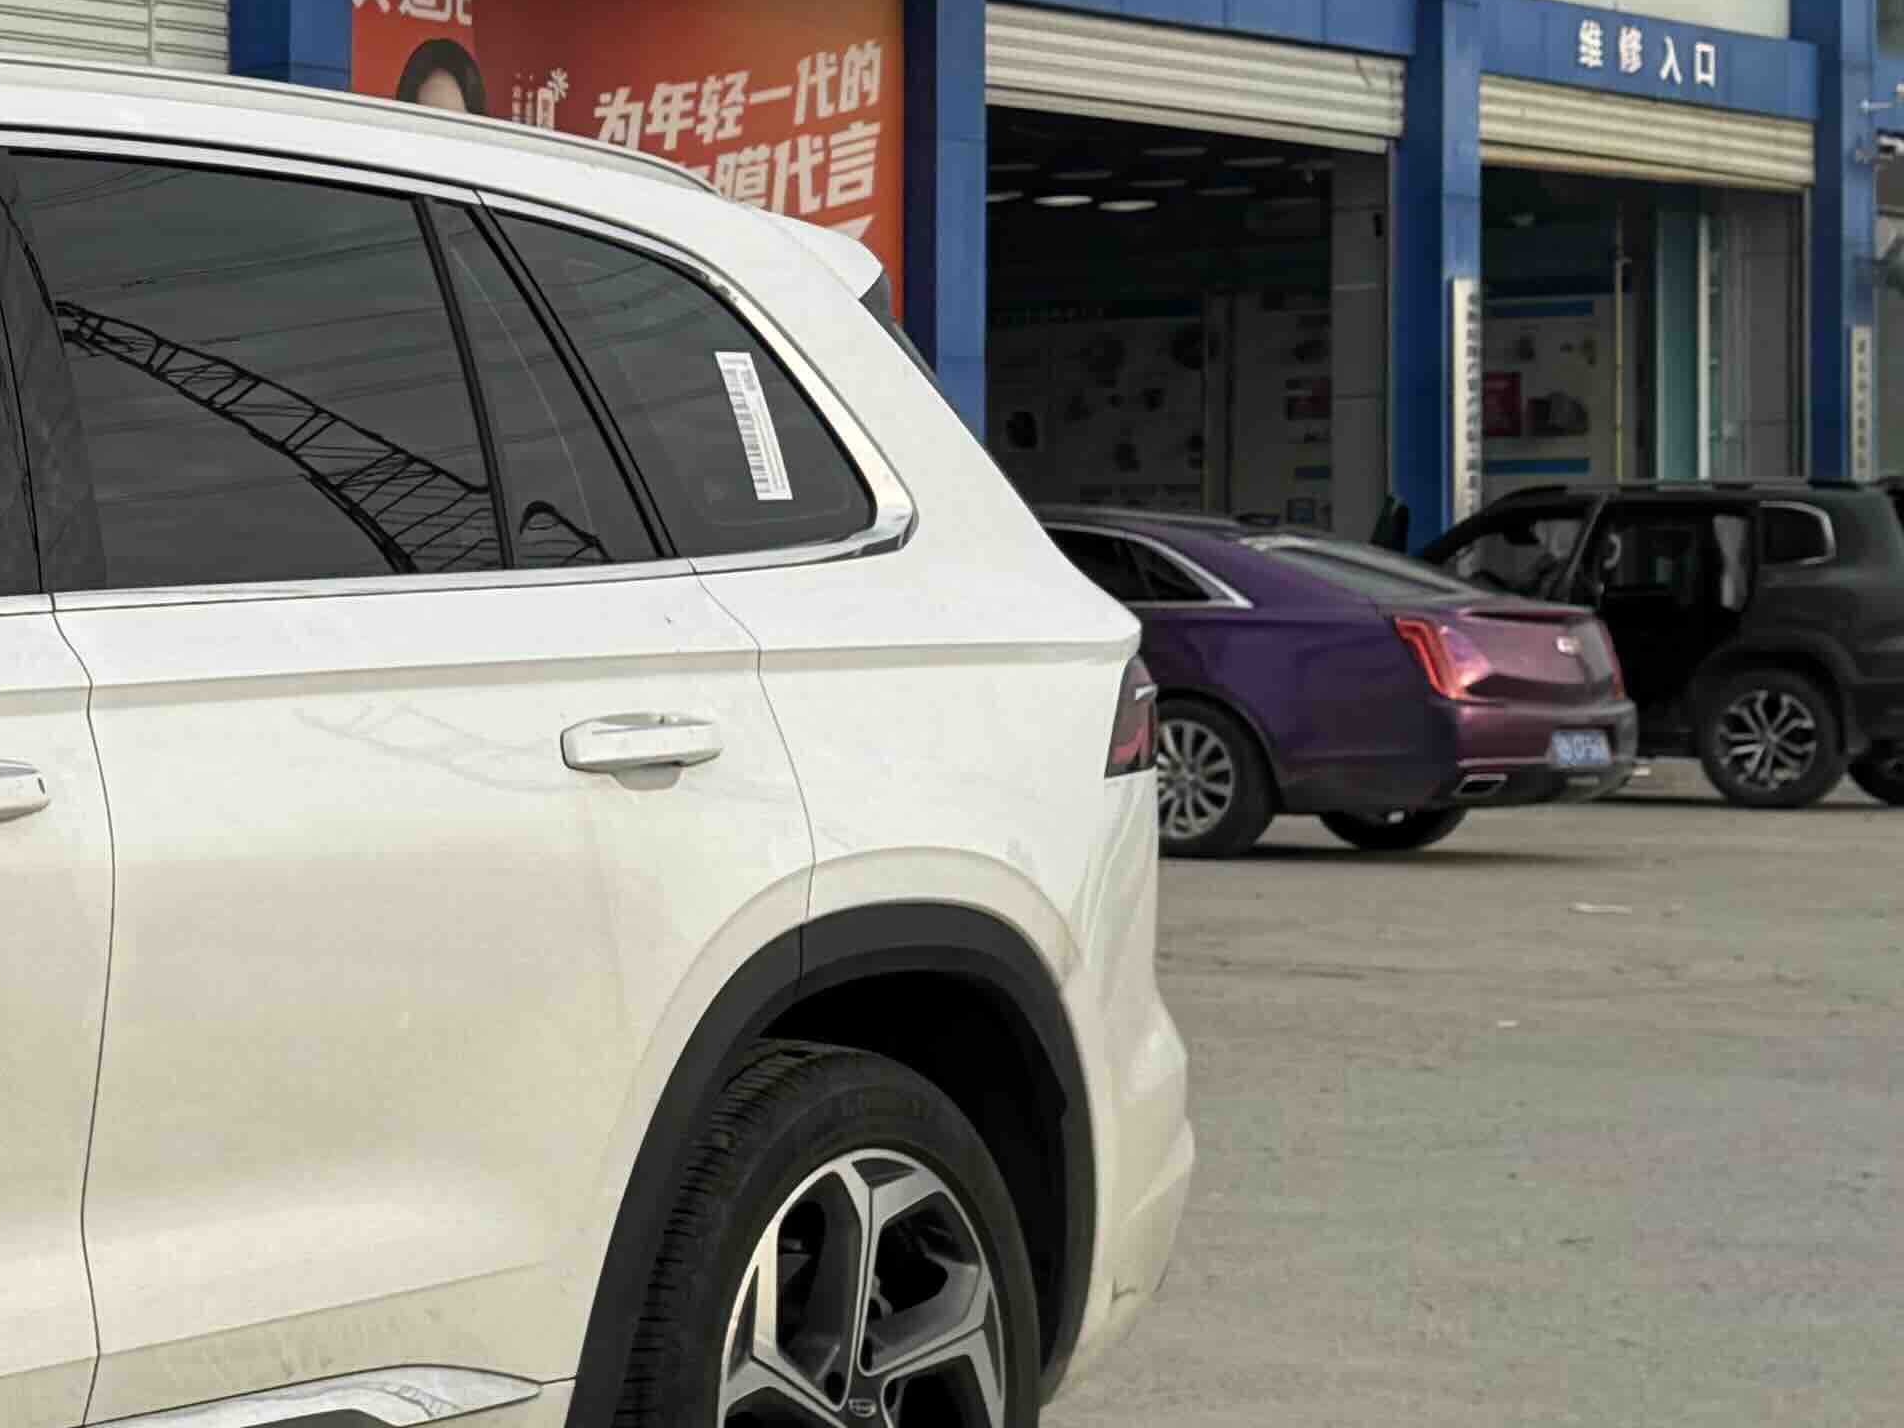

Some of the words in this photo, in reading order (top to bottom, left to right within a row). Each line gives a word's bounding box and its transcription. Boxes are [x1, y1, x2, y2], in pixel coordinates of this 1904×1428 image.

[593, 38, 882, 151] 为年轻一代的
[1577, 18, 1718, 88] 维修入口
[680, 120, 882, 215] 膜代言
